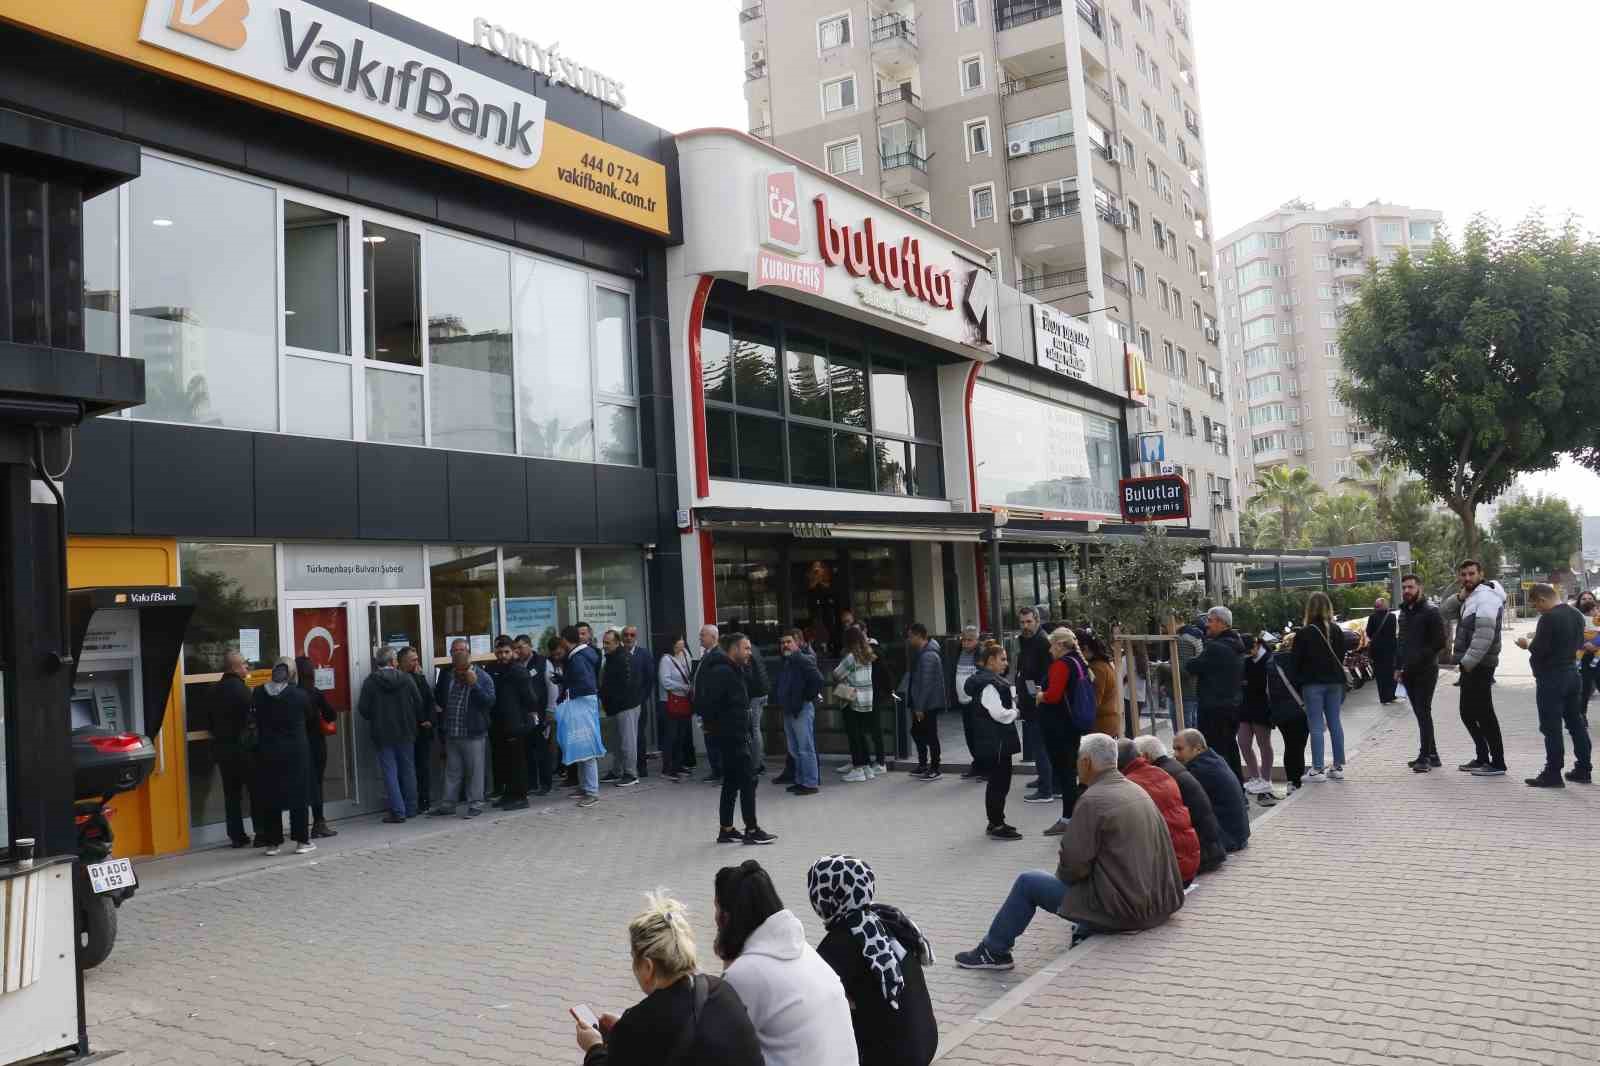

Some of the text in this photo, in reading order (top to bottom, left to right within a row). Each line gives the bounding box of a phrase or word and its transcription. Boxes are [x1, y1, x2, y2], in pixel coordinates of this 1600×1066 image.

[278, 7, 534, 155] VakıfBank
[580, 152, 604, 173] 444
[557, 166, 657, 213] vakifbank.com.tr
[1125, 485, 1181, 502] Bulutlar
[92, 863, 127, 878] 01 ADG
[105, 875, 122, 887] 153
